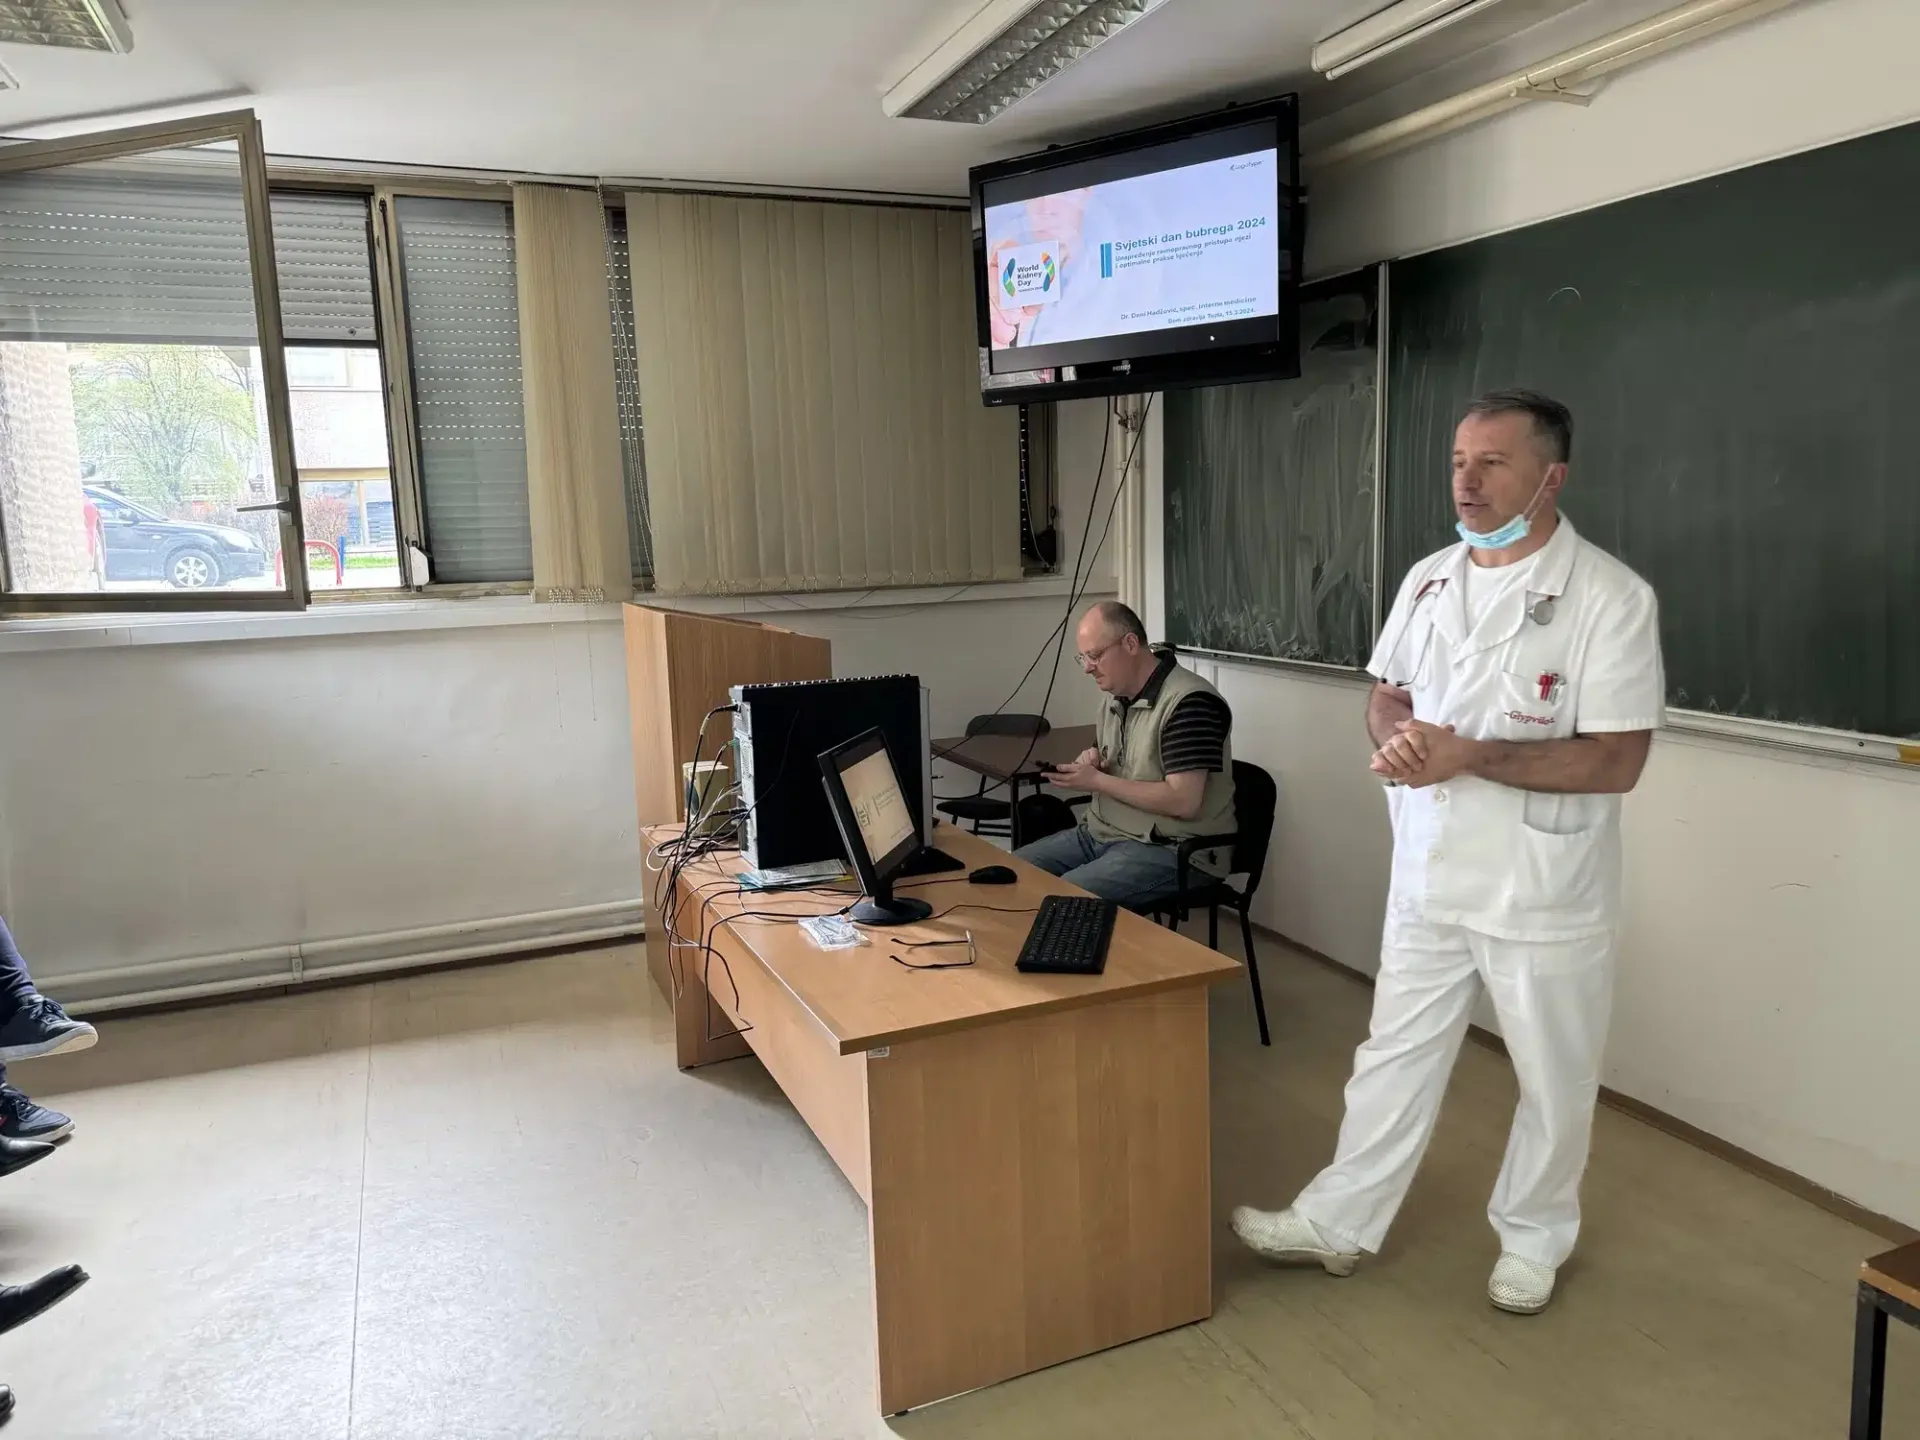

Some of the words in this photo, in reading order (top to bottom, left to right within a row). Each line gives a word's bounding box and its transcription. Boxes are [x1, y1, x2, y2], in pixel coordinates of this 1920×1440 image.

[1115, 234, 1158, 251] Svjetski
[1161, 232, 1182, 243] dan
[1185, 223, 1234, 239] bubrega
[1237, 216, 1266, 230] 2024
[1204, 237, 1233, 248] pristupa
[1017, 264, 1039, 273] World
[1017, 271, 1042, 280] Kidney
